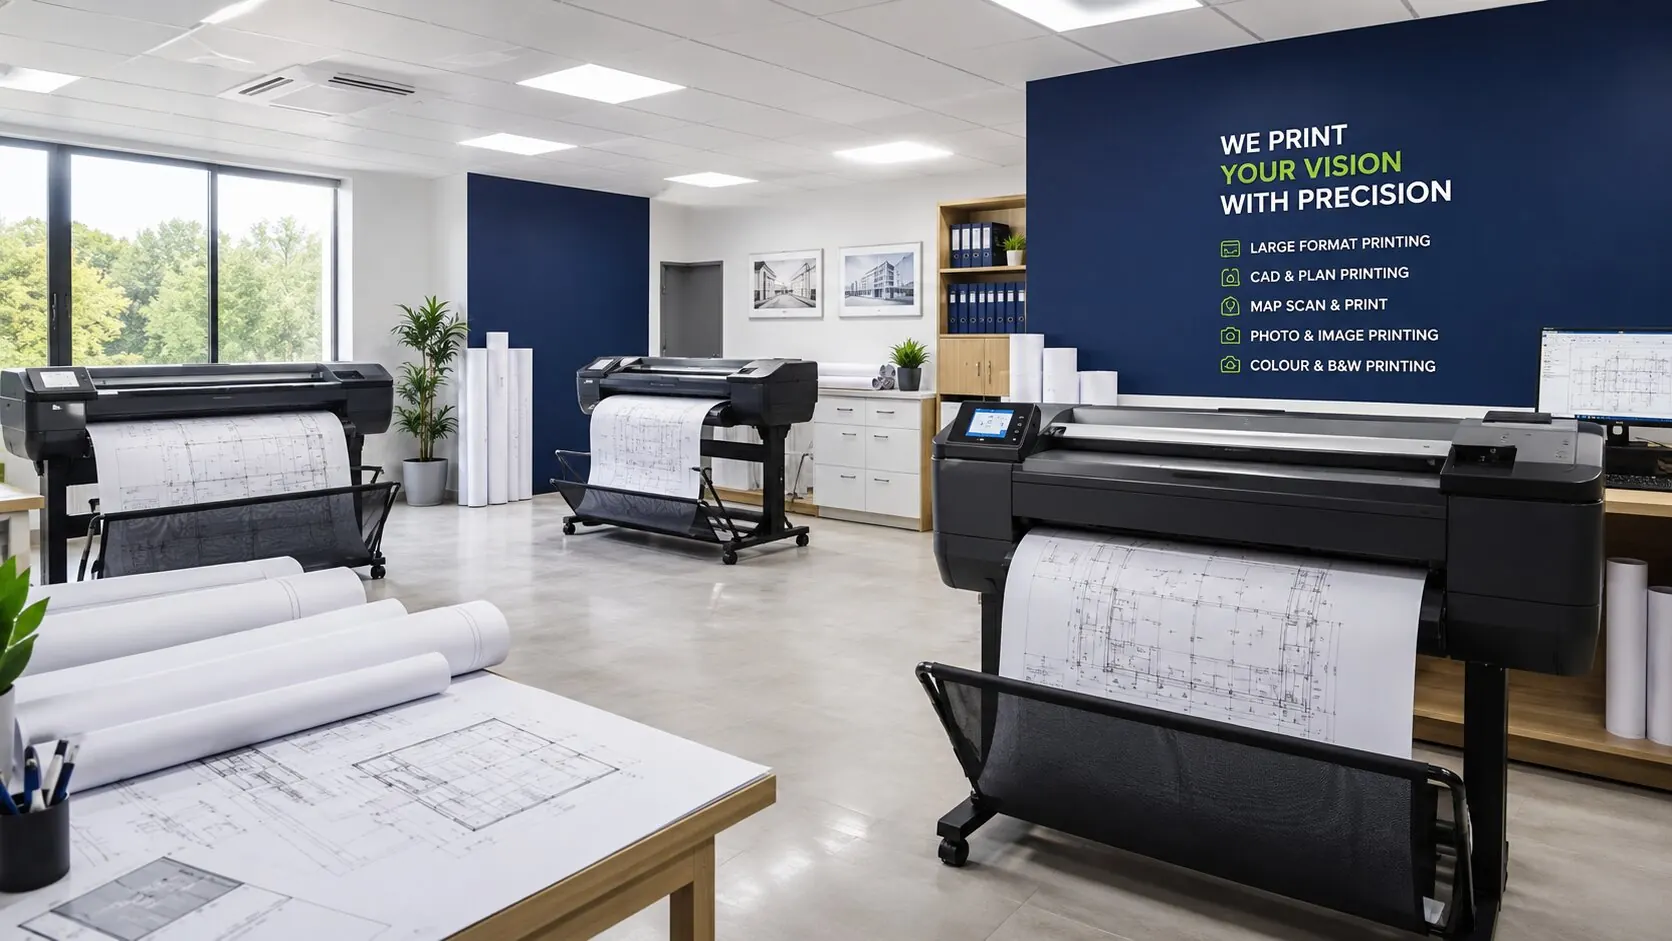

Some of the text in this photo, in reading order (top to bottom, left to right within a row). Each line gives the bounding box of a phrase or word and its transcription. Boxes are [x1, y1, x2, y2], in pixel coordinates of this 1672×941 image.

[1220, 124, 1348, 155] WE PRINT
[1221, 150, 1402, 184] YOUR VISION
[1220, 180, 1452, 215] WITH PRECISION
[1250, 234, 1431, 254] LARGE FORMAT PRINTING
[1250, 266, 1410, 283] CAD & PLAN PRINTING
[1250, 297, 1389, 313] MAP SCAN & PRINT
[1250, 328, 1439, 342] PHOTO & IMAGE PRINTING
[1250, 359, 1436, 373] COLOUR & B&W PRINTING
